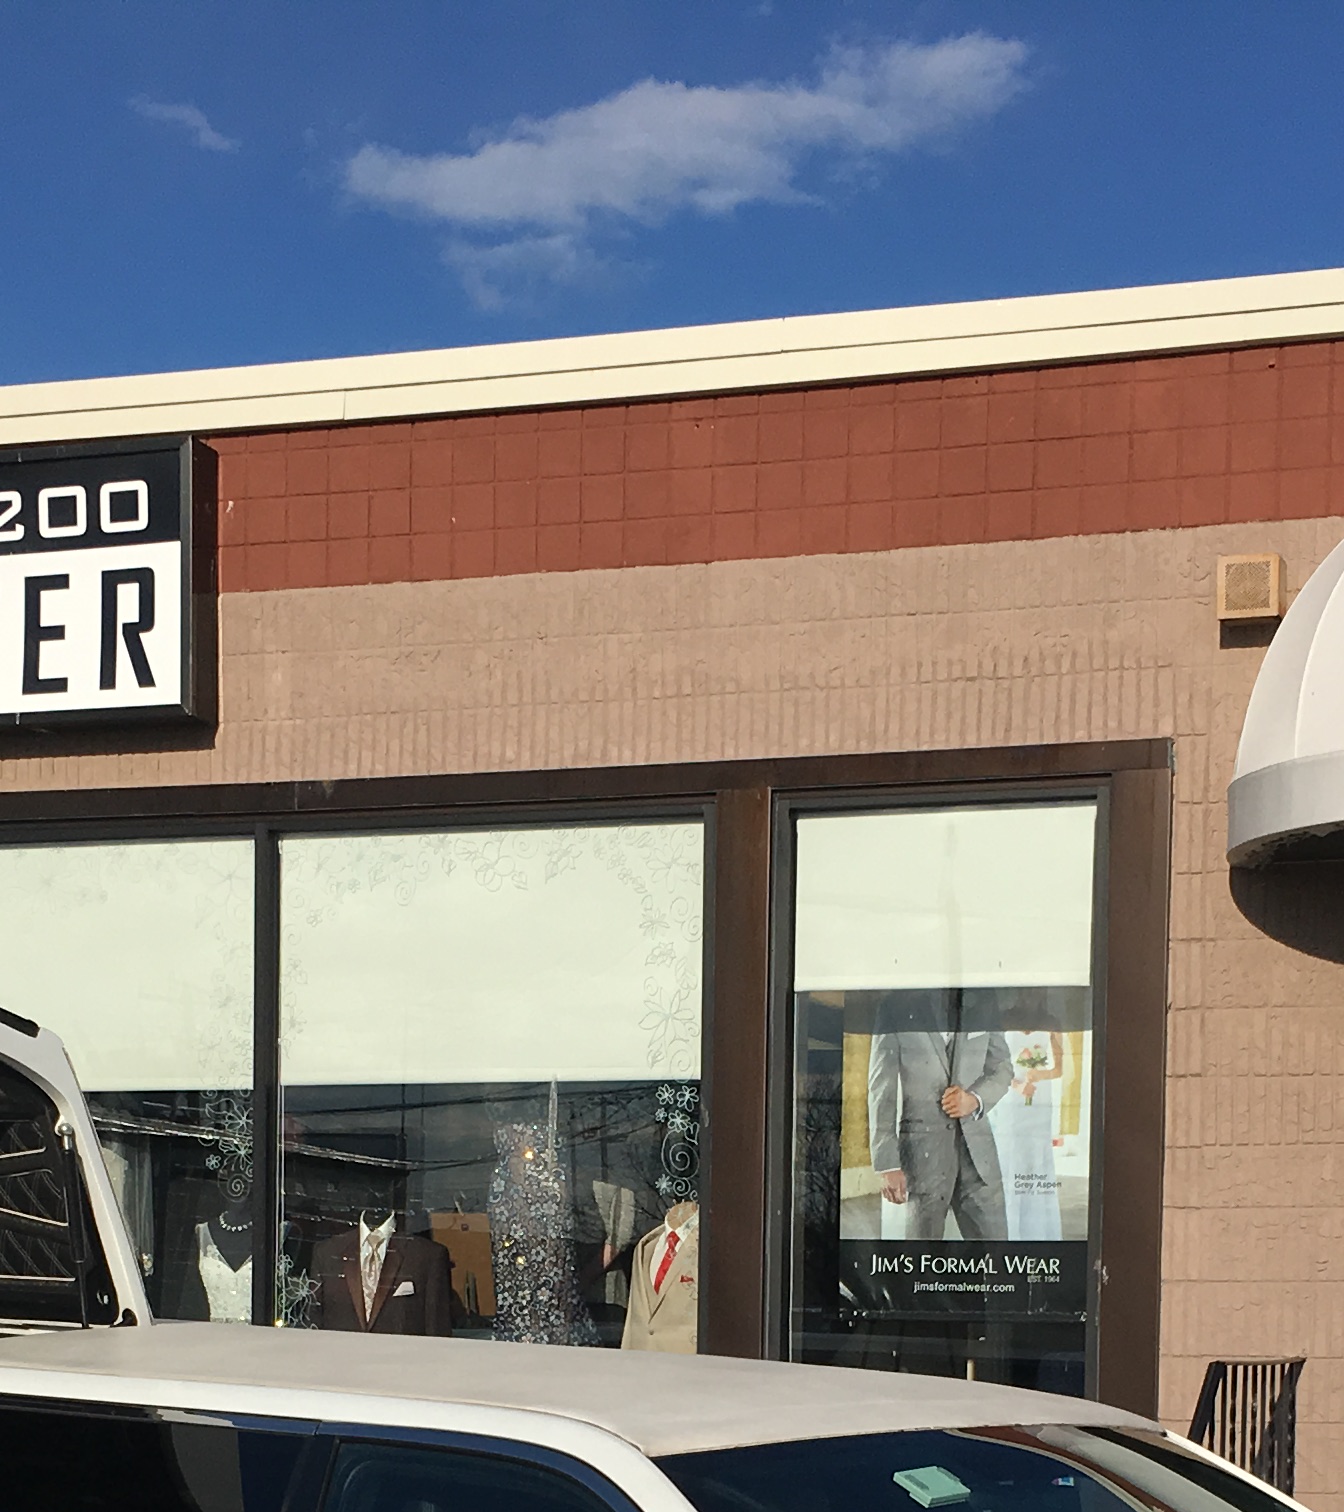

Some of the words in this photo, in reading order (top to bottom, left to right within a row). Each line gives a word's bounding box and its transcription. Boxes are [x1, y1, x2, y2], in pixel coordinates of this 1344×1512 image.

[870, 1254, 914, 1276] JIM'S
[920, 1254, 998, 1274] FORMAL
[1004, 1255, 1060, 1274] WEAR
[913, 1280, 1015, 1293] jimsformalwear.com
